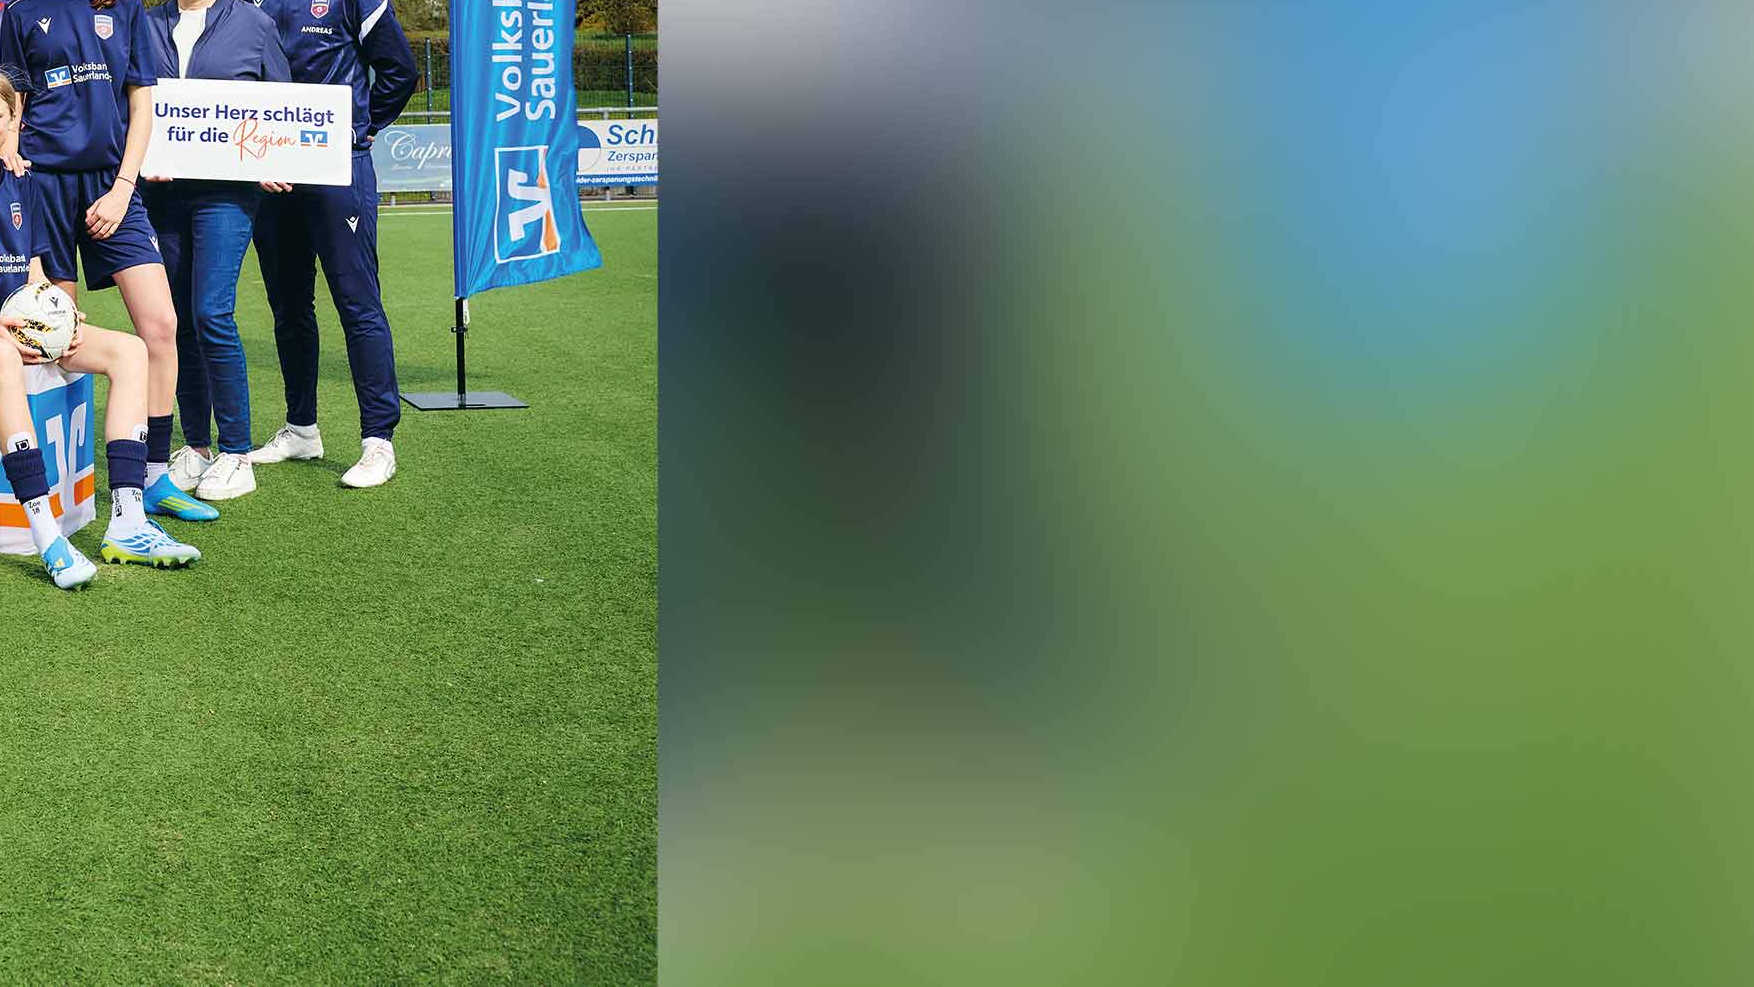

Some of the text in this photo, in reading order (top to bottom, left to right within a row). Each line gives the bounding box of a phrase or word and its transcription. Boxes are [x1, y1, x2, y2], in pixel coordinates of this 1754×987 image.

[301, 26, 333, 35] ANDREAS
[71, 62, 108, 73] Voksban
[155, 102, 335, 126] Unser Herz schlägt
[167, 118, 296, 162] für die Region
[606, 123, 655, 146] Sch
